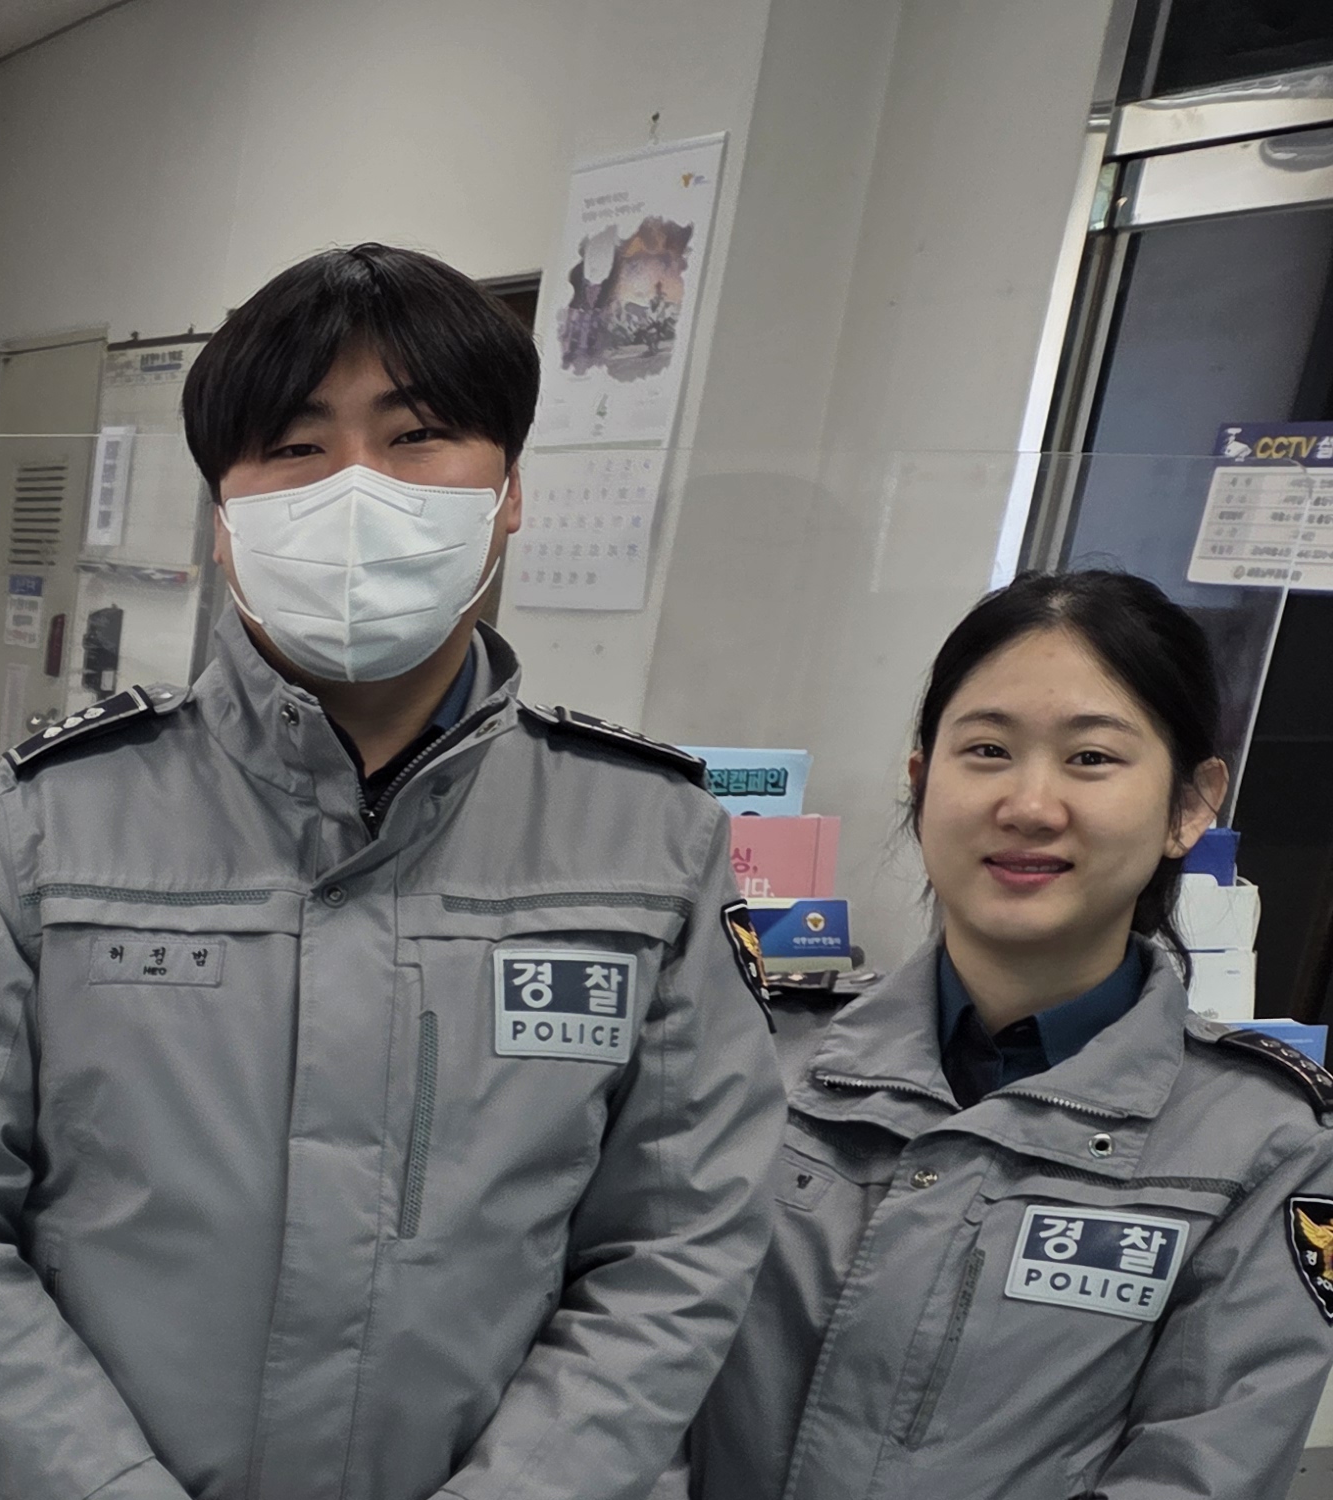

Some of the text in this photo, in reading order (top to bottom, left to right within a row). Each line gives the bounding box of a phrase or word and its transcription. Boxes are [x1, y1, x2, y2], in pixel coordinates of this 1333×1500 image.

[1255, 437, 1316, 458] CCTV
[143, 965, 167, 976] HEO
[512, 1020, 621, 1048] POLICE
[1024, 1267, 1155, 1307] POLICE
